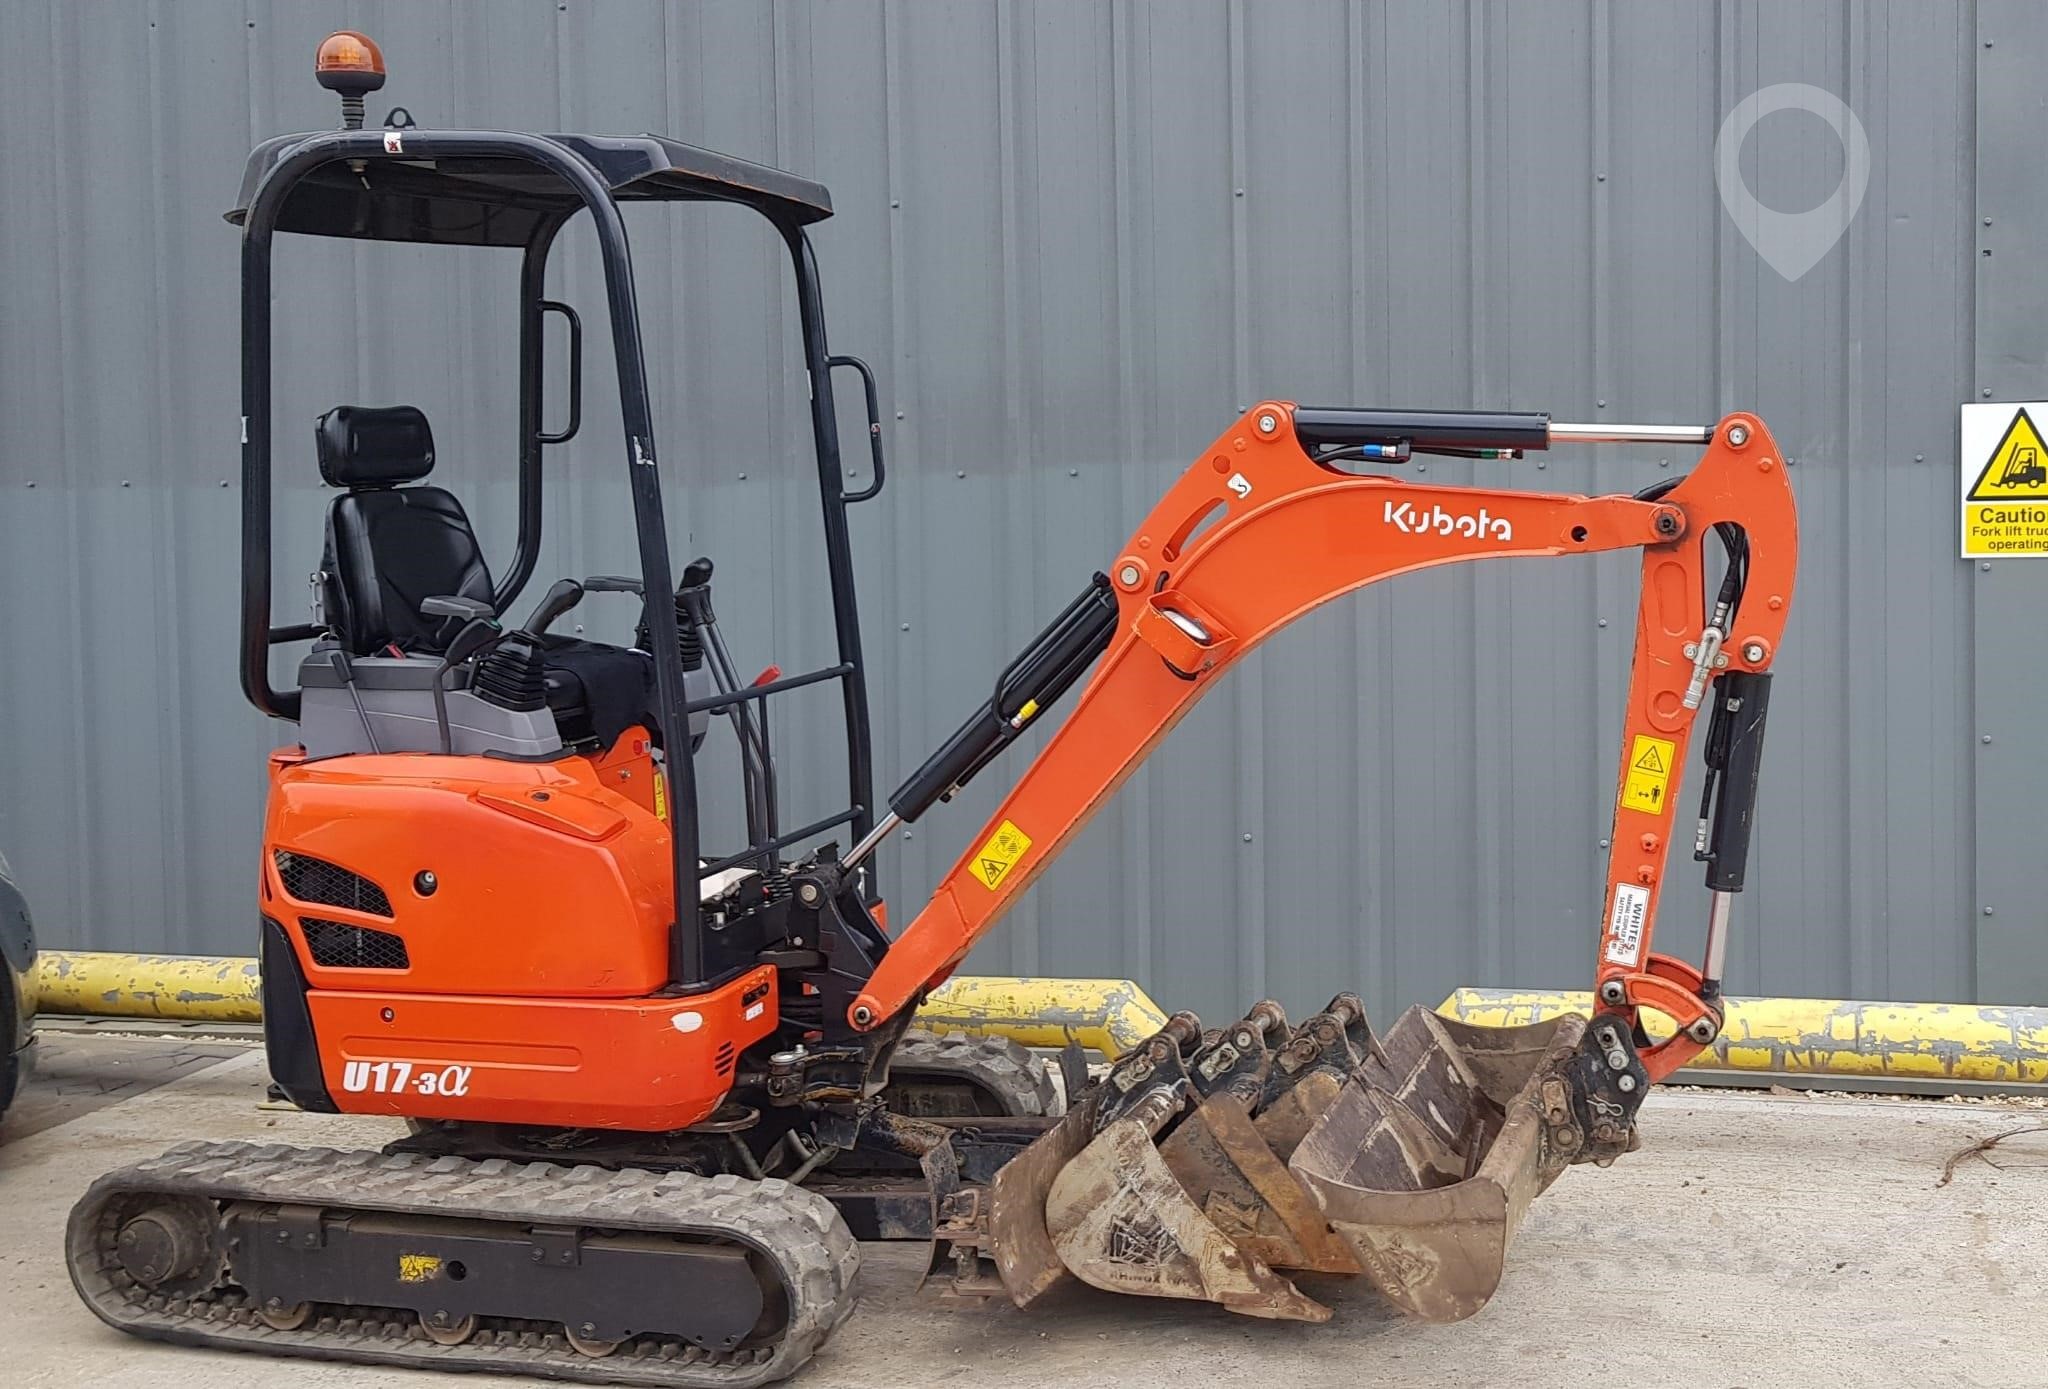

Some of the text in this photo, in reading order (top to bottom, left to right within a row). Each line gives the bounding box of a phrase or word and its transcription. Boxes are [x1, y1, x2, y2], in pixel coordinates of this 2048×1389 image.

[1384, 501, 1512, 541] Kubota
[1980, 507, 2048, 524] Cautio
[1972, 526, 2001, 537] Fork
[2005, 525, 2022, 537] lift
[1988, 539, 2048, 552] operating
[1627, 903, 1643, 951] WHITES
